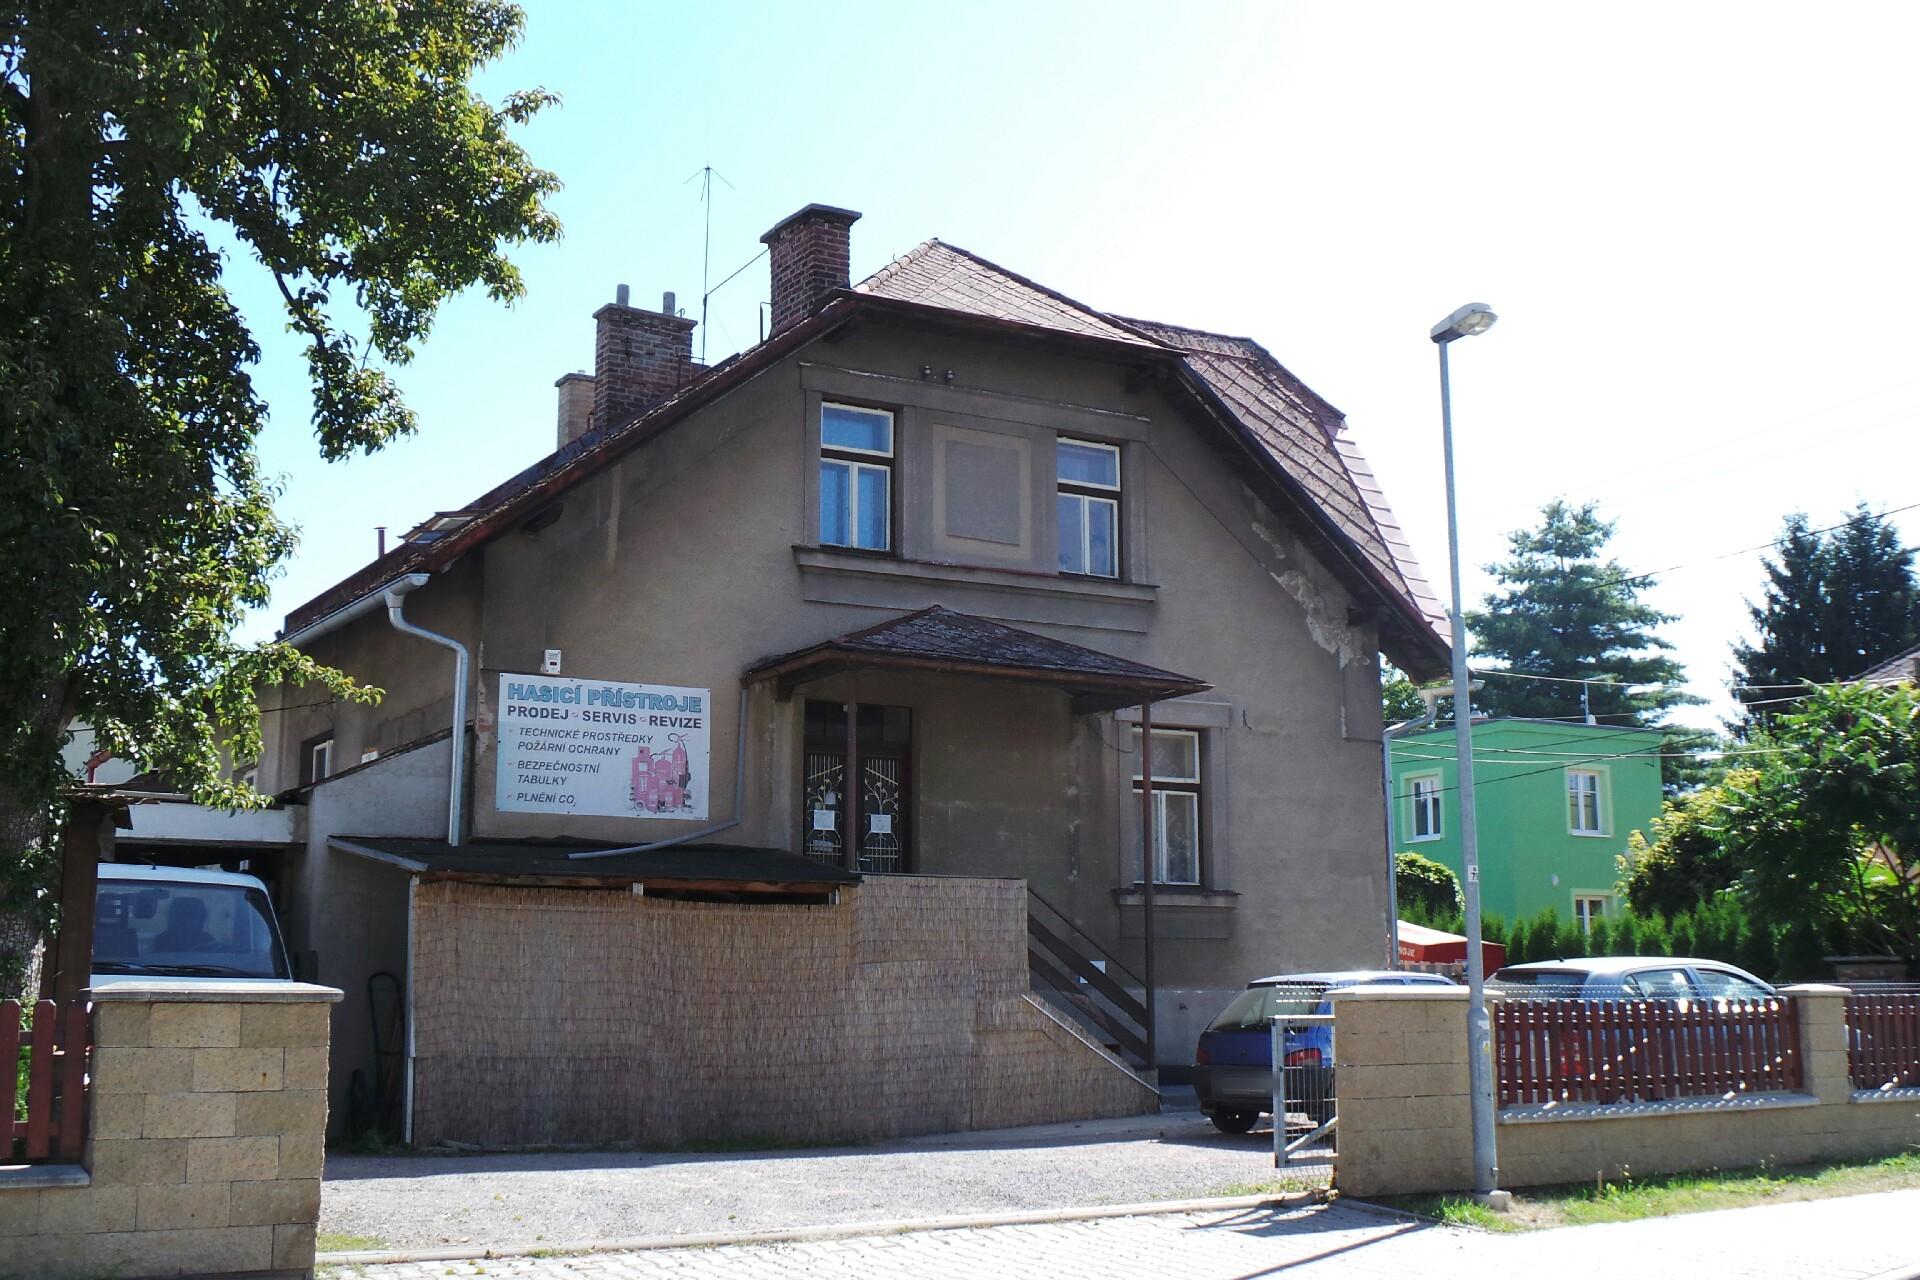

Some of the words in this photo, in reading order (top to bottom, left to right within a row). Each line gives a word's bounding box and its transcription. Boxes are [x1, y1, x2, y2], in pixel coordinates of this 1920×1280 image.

[507, 682, 582, 704] HASICÍ
[588, 687, 702, 713] PŘÍSTROJE
[507, 705, 569, 720] PRODEJ
[582, 710, 637, 724] SERVIS
[649, 716, 702, 729] REVIZE
[519, 727, 580, 739] TECHNICKÉ
[582, 731, 654, 744] PROSTŘEDKY
[517, 741, 567, 753] POŽÁRNÍ
[568, 744, 620, 756] OCHRANY
[517, 760, 601, 773] BEZPEČNOSTNÍ
[517, 775, 567, 786] TABULKY
[516, 792, 557, 804] PLNĚNÍ
